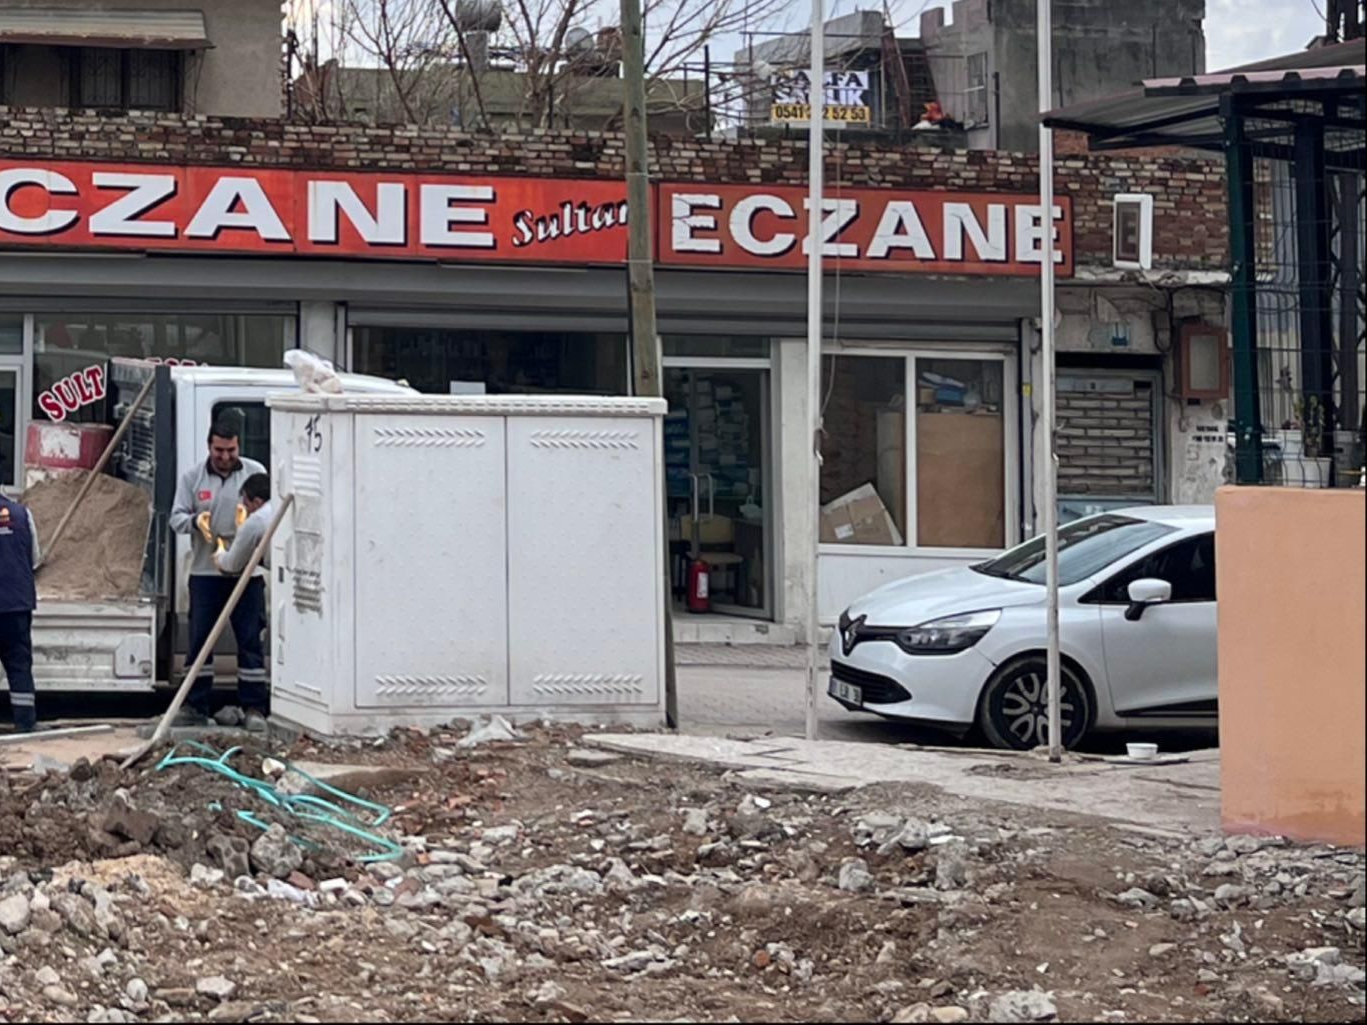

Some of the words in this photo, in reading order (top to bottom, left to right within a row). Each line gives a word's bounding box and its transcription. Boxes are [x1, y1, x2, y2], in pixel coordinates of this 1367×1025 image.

[775, 106, 803, 119] 0541
[850, 108, 866, 120] 53
[671, 193, 1063, 264] ECZANE
[38, 364, 106, 422] SULT
